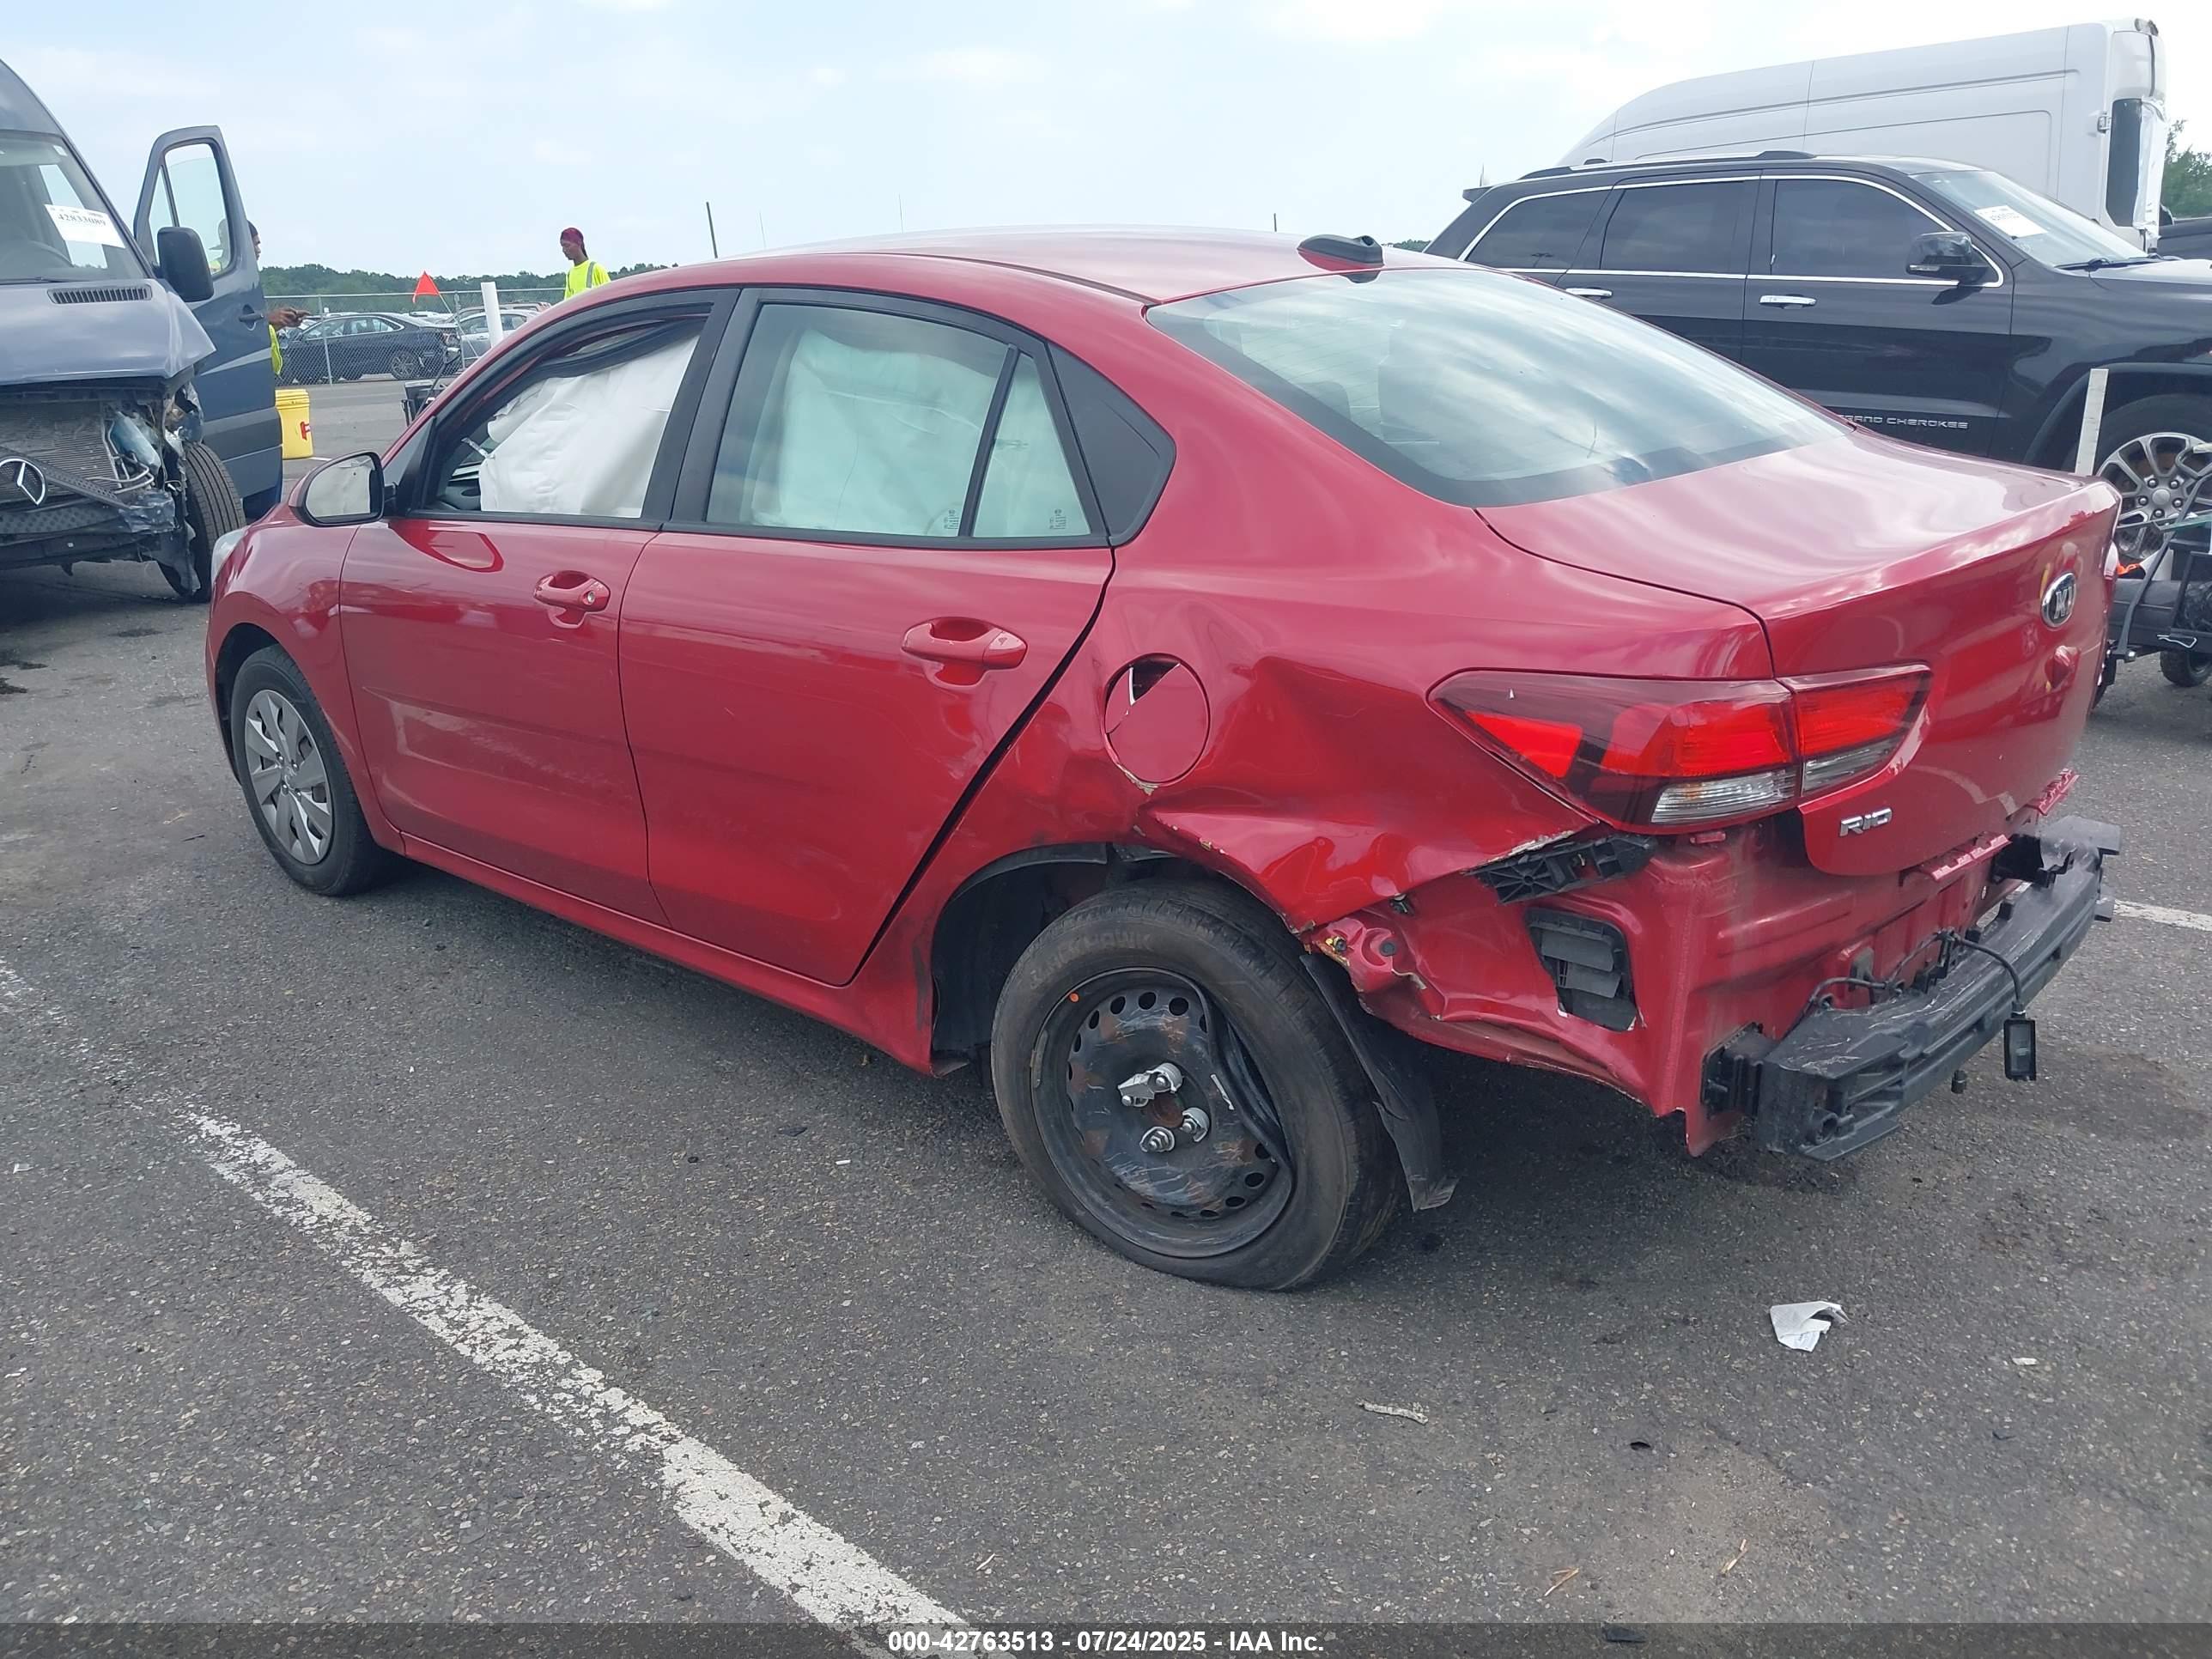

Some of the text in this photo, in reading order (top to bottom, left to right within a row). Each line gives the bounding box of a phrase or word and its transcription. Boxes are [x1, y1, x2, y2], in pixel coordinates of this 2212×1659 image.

[1839, 415, 1968, 428] RAND CHEROKEE
[1839, 806, 1893, 836] RIO
